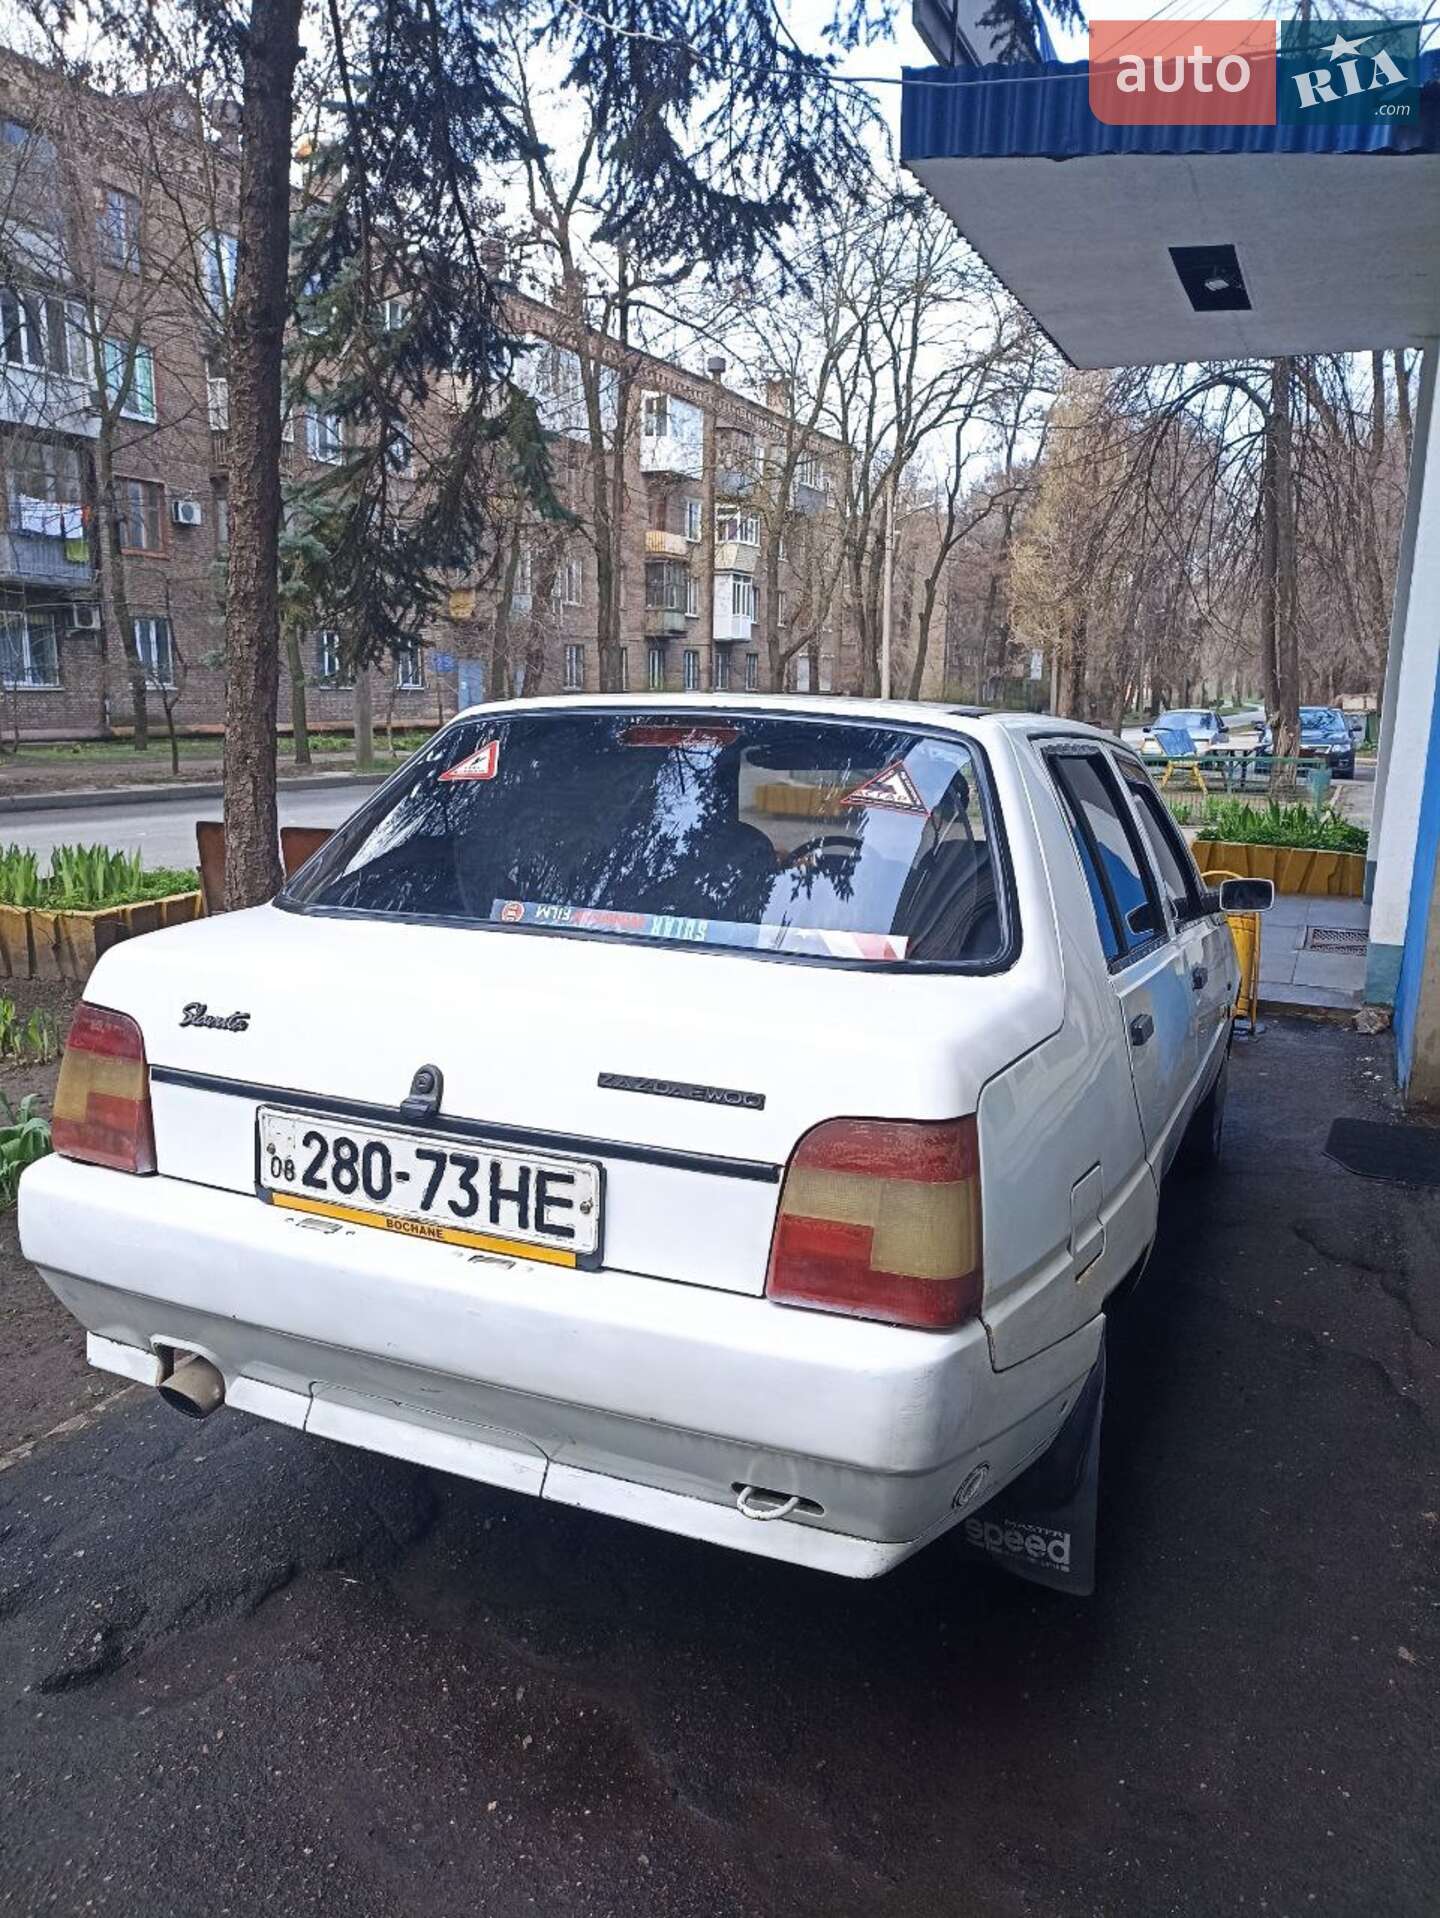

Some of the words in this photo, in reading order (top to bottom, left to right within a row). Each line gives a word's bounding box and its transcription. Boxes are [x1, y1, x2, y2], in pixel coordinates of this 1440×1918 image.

[535, 902, 572, 921] FILM
[270, 1155, 296, 1181] 08
[386, 1218, 444, 1239] BOCHANE
[964, 1519, 1071, 1565] speed
